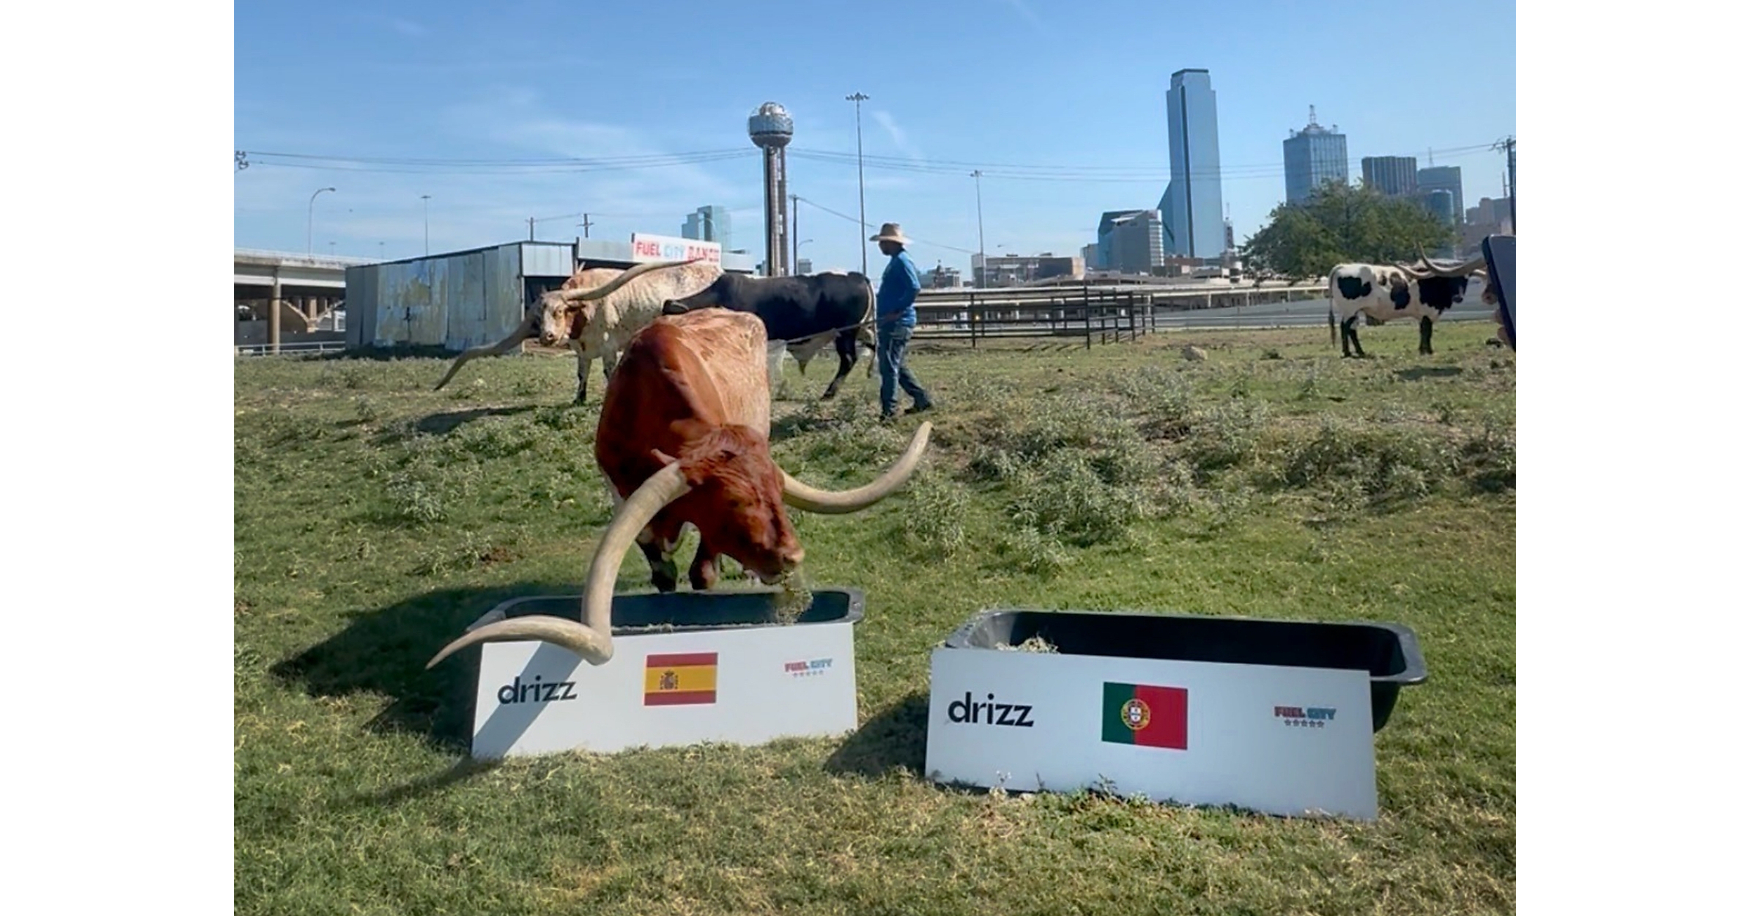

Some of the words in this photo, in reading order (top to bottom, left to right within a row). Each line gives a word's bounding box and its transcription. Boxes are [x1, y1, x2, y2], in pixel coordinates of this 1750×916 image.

[636, 241, 661, 257] FUEL
[663, 244, 686, 259] CITY
[497, 675, 578, 704] drizz
[948, 691, 1034, 727] drizz
